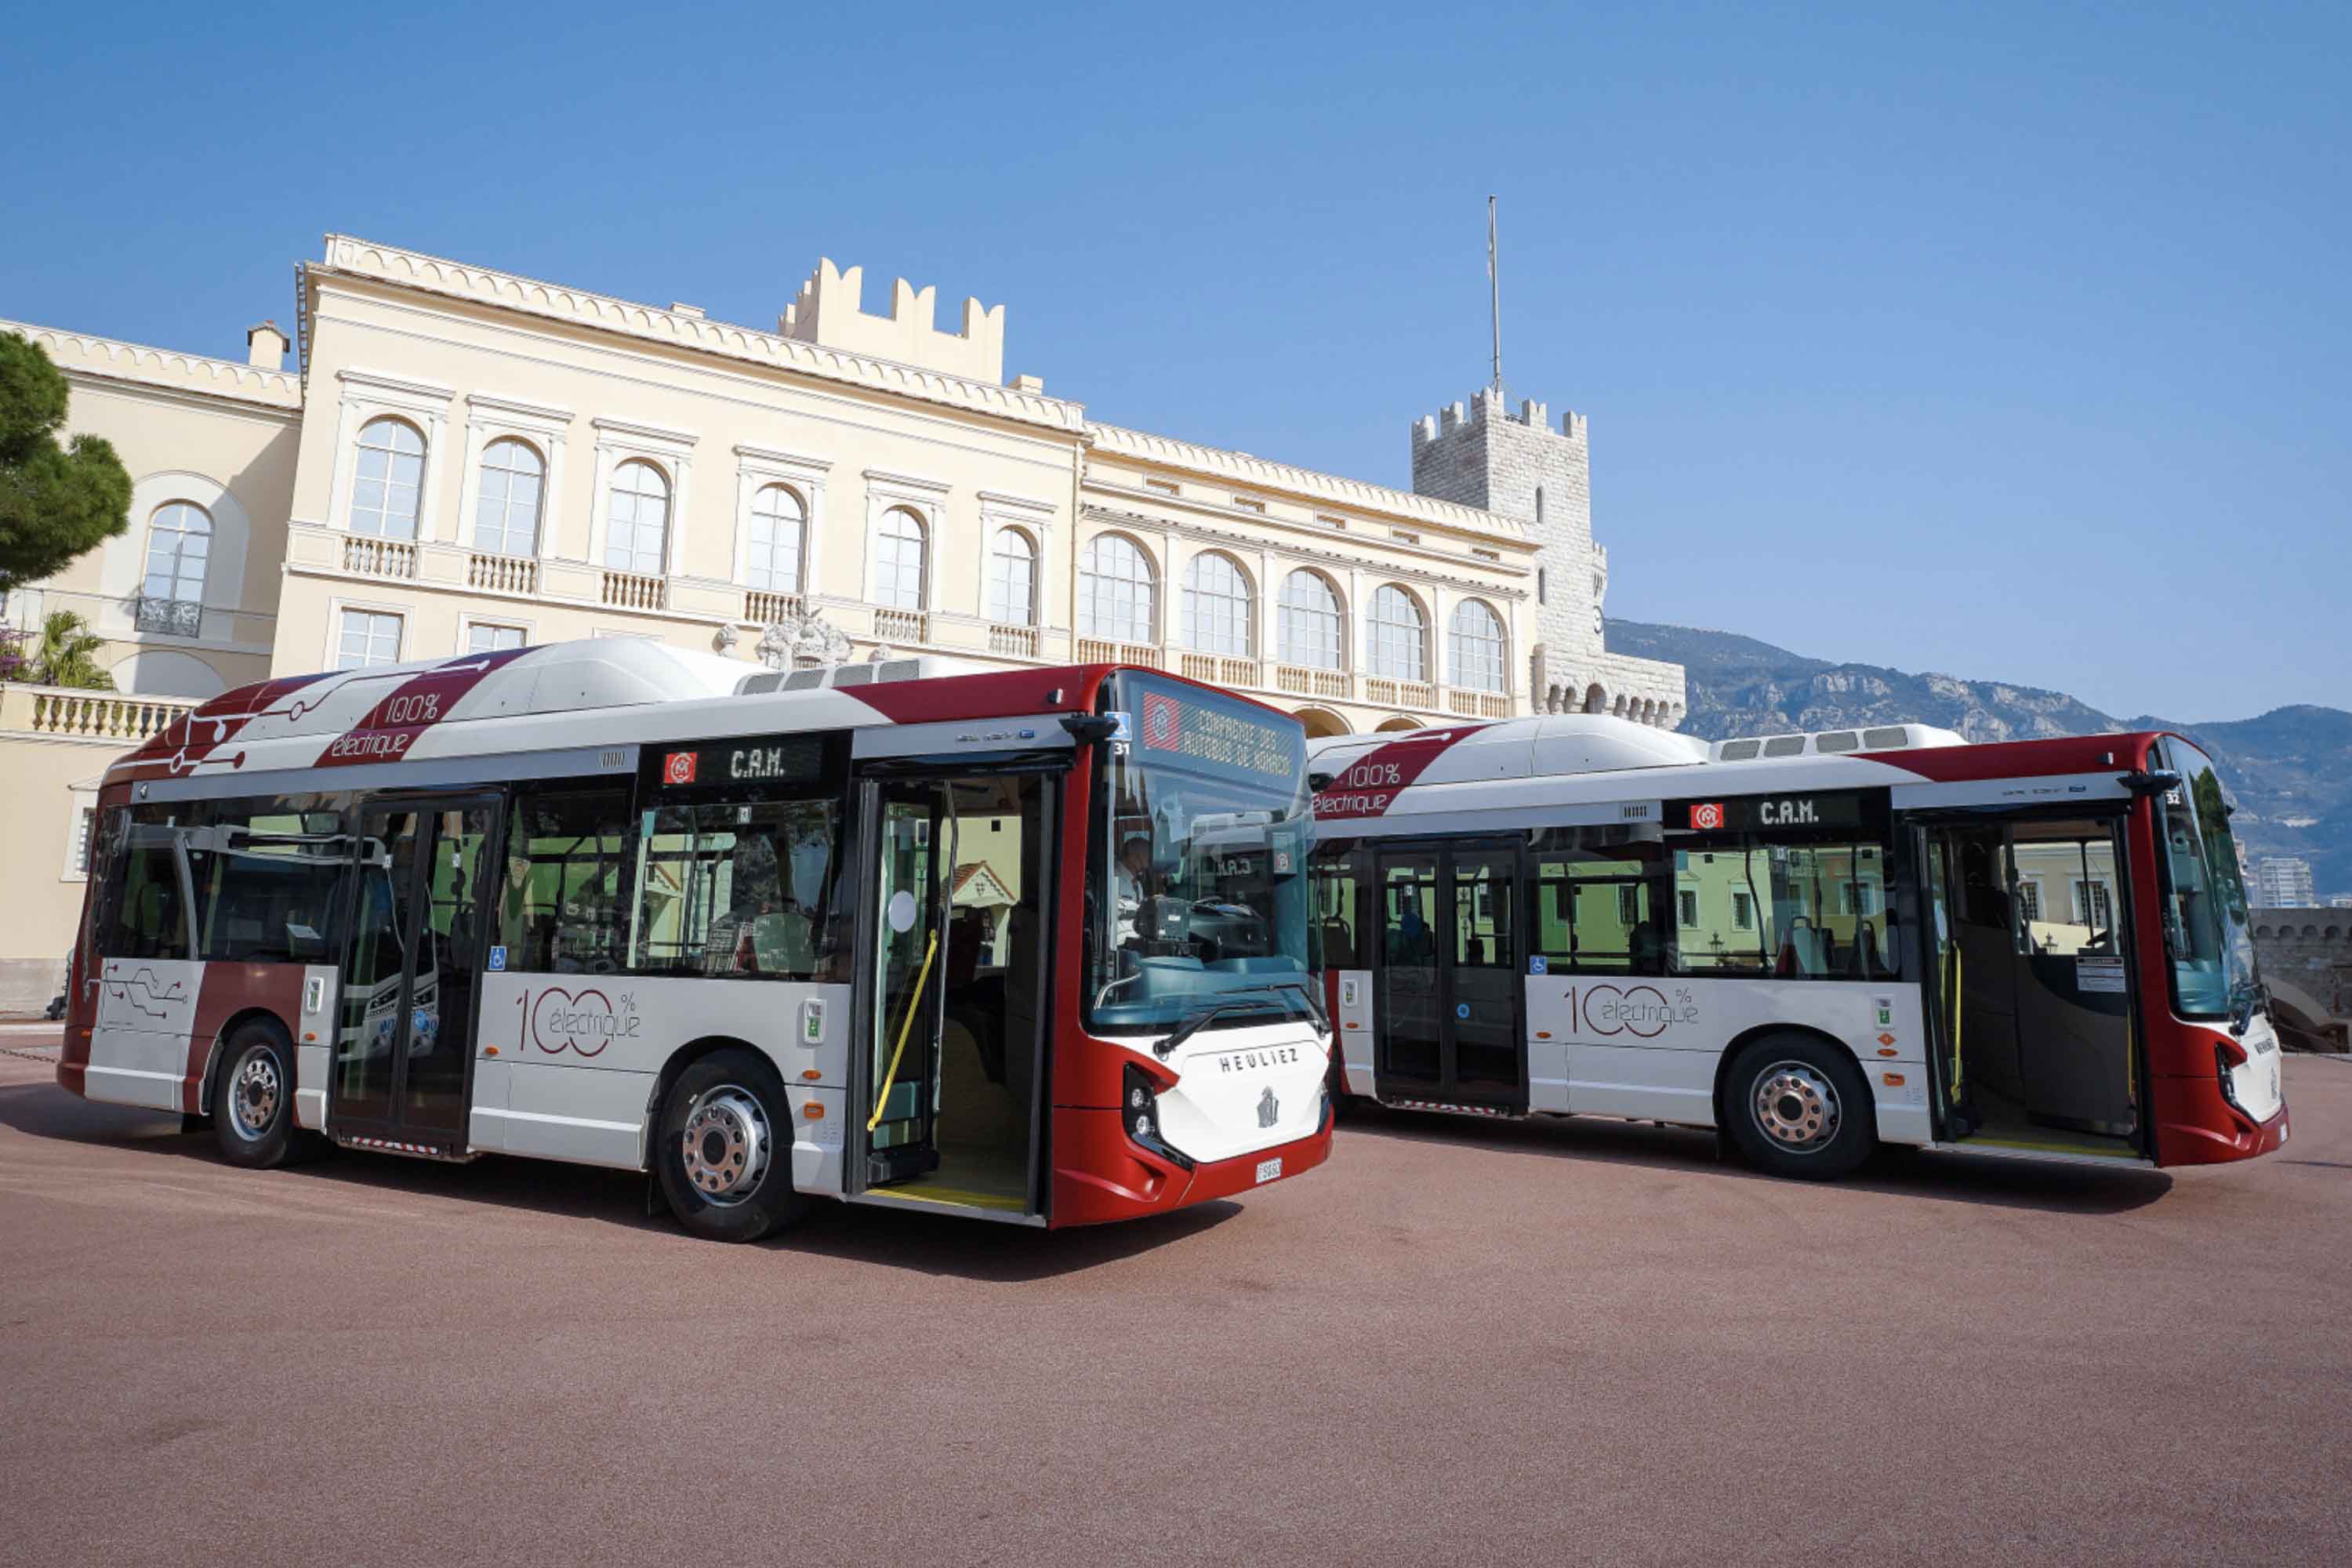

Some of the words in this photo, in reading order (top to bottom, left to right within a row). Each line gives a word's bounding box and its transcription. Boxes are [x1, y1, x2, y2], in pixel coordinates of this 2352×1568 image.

[384, 693, 441, 723] 100%
[332, 732, 408, 758] électrique
[1113, 742, 1130, 755] 31
[731, 747, 785, 779] C.A.M.
[1348, 763, 1401, 789] 100%
[2166, 793, 2181, 804] 32
[1760, 800, 1820, 825] C.A.M.
[1218, 1048, 1298, 1073] HEULIEZ
